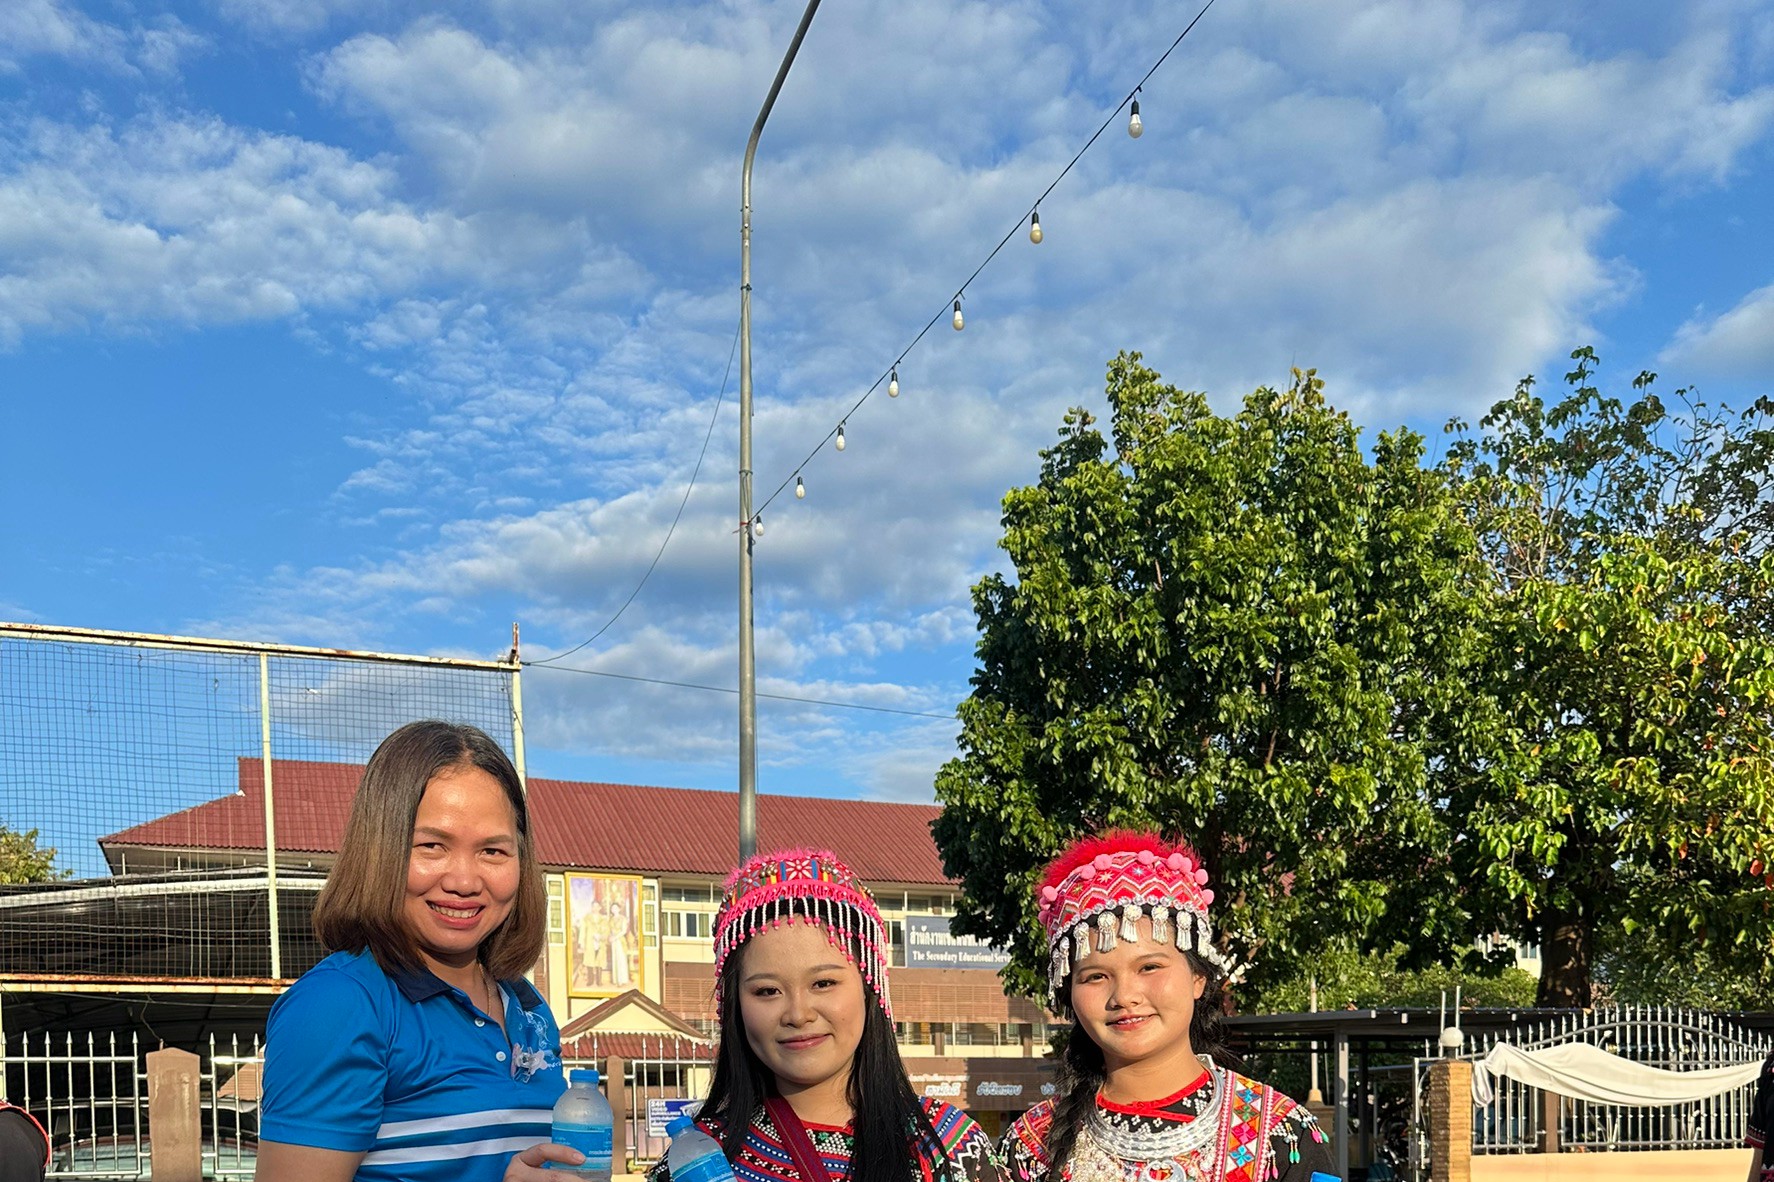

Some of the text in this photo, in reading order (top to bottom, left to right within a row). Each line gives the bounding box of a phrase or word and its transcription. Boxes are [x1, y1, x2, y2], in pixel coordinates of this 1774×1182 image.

[912, 950, 925, 961] The
[926, 950, 958, 964] Secondary
[959, 951, 994, 963] Educational
